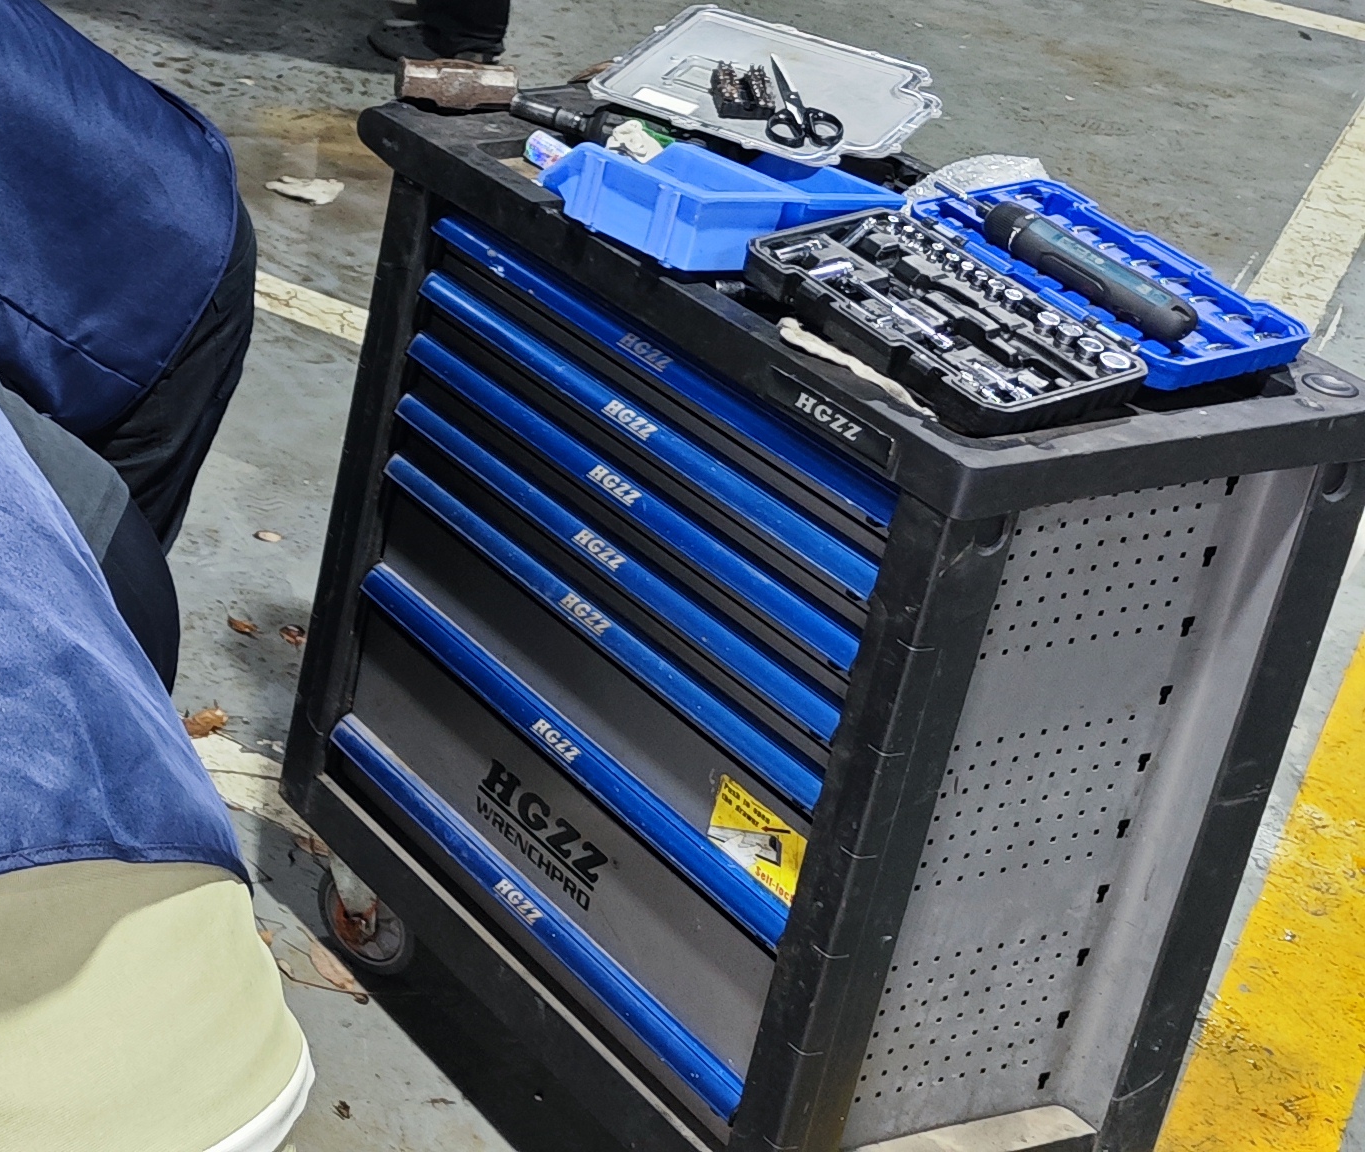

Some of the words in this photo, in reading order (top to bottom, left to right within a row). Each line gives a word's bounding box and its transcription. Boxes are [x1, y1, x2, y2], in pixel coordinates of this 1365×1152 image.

[617, 332, 674, 371] HGZZ
[602, 399, 659, 440] HGZZ
[795, 392, 863, 441] HGZZ
[587, 464, 642, 505] HGZZ
[572, 528, 627, 570] HGZZ
[559, 592, 612, 635] HGZZ
[531, 718, 582, 762] HGZZ
[724, 782, 741, 800] Push
[481, 758, 609, 884] HGZZ
[475, 795, 591, 912] WRENCHPRO
[494, 878, 544, 925] HGZZ
